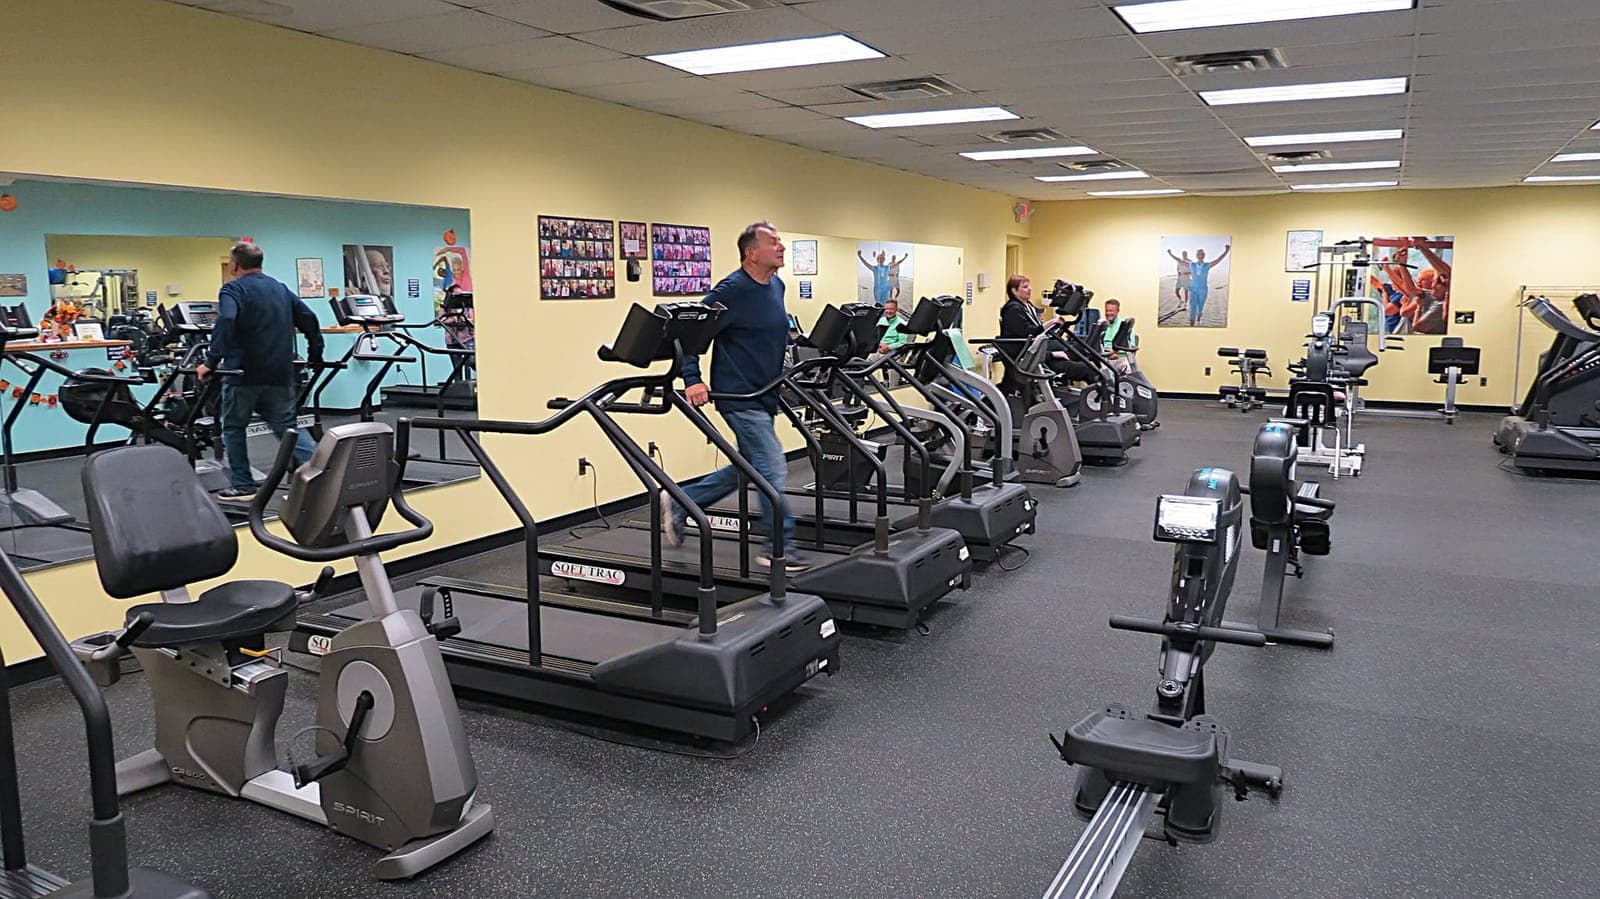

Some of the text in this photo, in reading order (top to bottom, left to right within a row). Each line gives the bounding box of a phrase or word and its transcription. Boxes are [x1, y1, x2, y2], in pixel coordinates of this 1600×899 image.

[820, 453, 845, 461] PIRIT
[554, 562, 624, 580] SOFT TRAC
[312, 636, 329, 650] SO
[333, 801, 385, 827] SPIRIT
